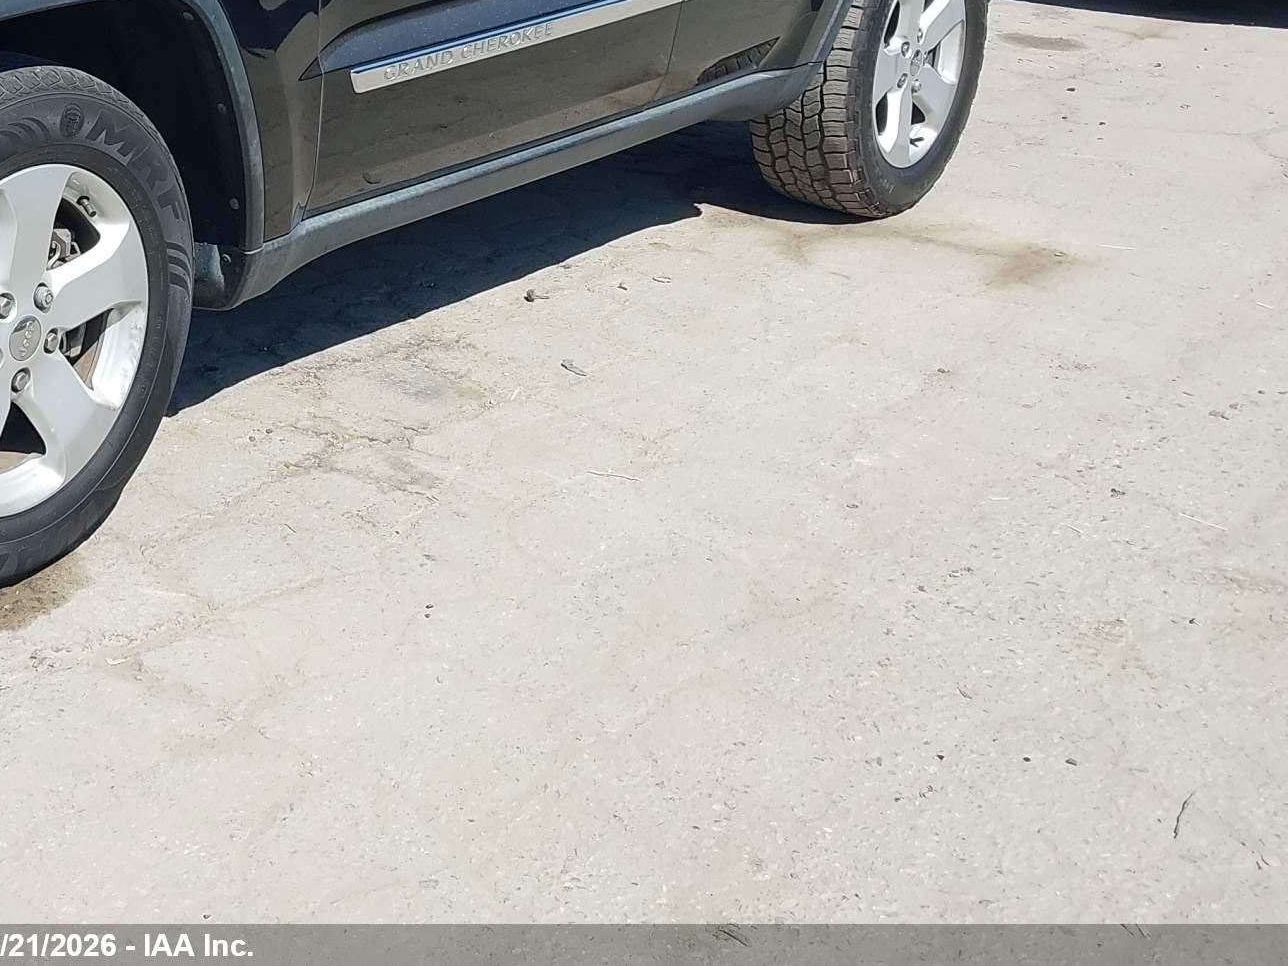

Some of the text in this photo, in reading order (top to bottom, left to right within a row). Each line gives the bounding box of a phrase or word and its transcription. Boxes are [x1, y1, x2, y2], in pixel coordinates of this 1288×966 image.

[383, 22, 554, 81] GRAND CHEROKEE
[85, 110, 186, 222] MRF
